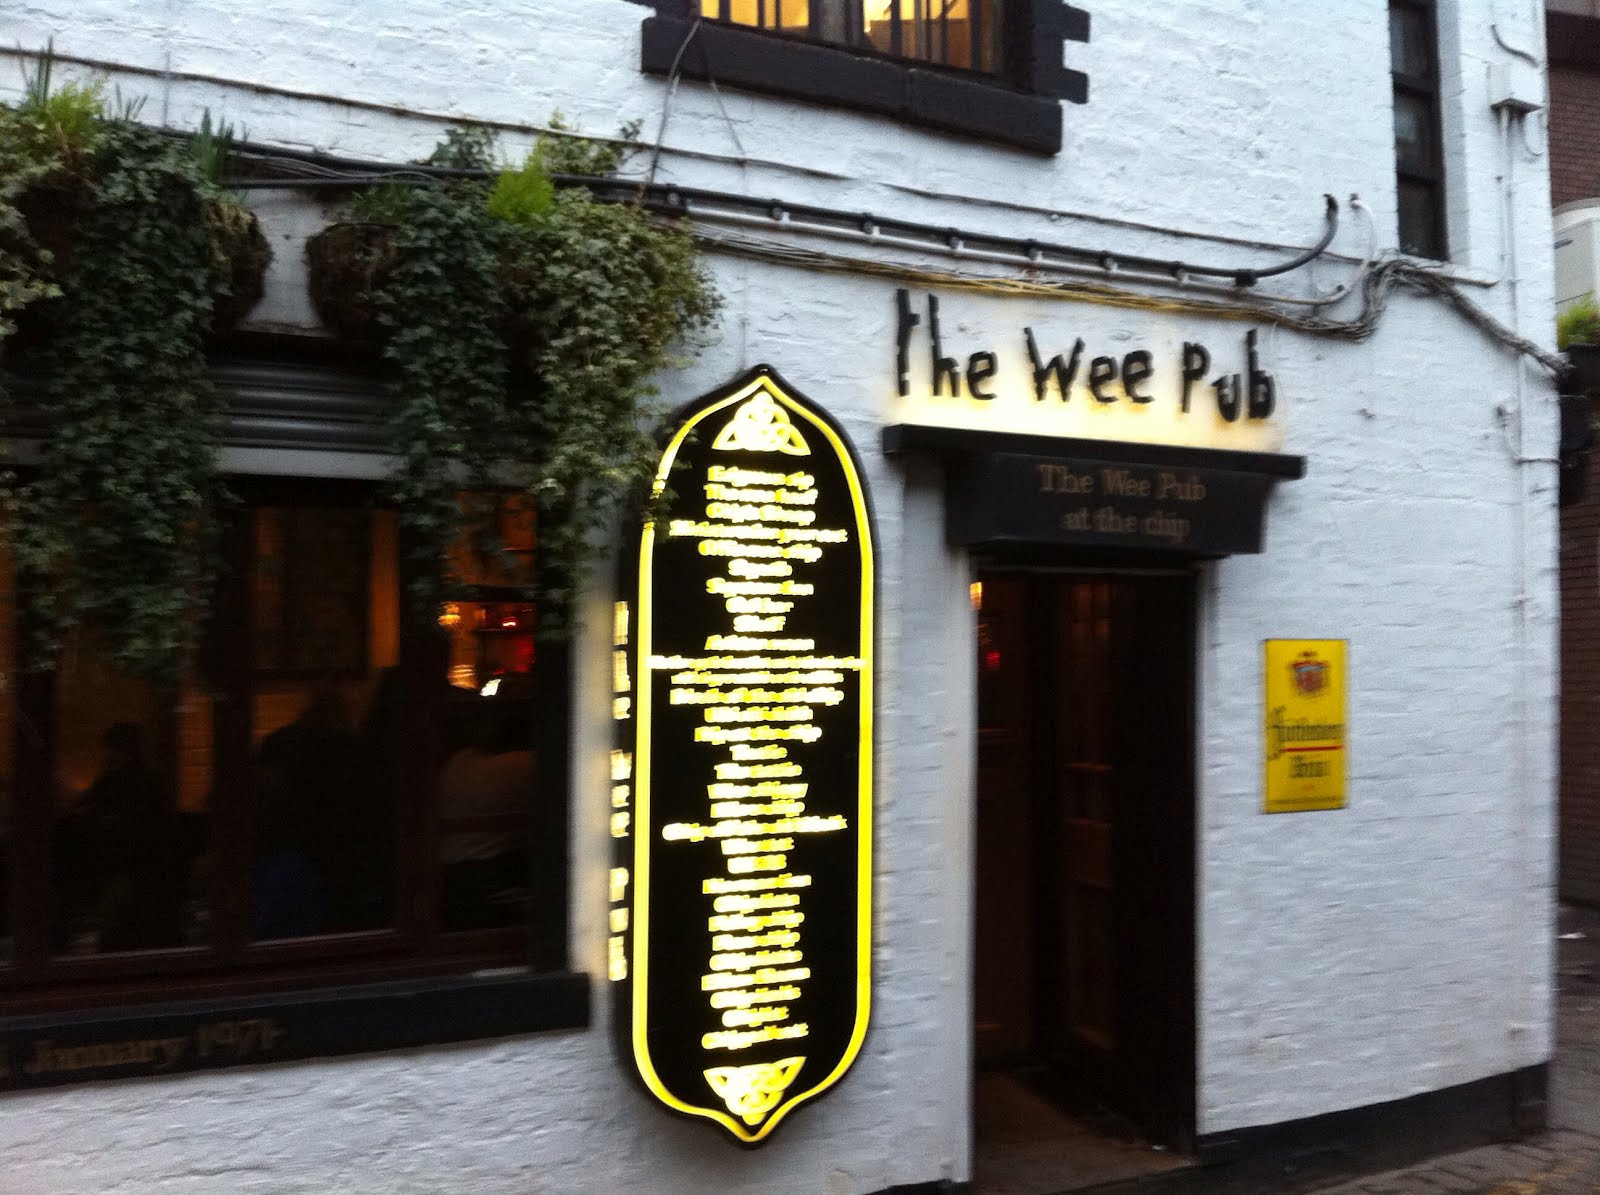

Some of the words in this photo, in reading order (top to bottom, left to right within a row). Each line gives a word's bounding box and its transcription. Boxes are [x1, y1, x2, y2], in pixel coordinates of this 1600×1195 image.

[1023, 326, 1155, 404] Wee
[1181, 328, 1277, 423] Pub
[1037, 463, 1095, 494] The
[1102, 468, 1152, 497] Wee
[1156, 472, 1207, 502] Pub
